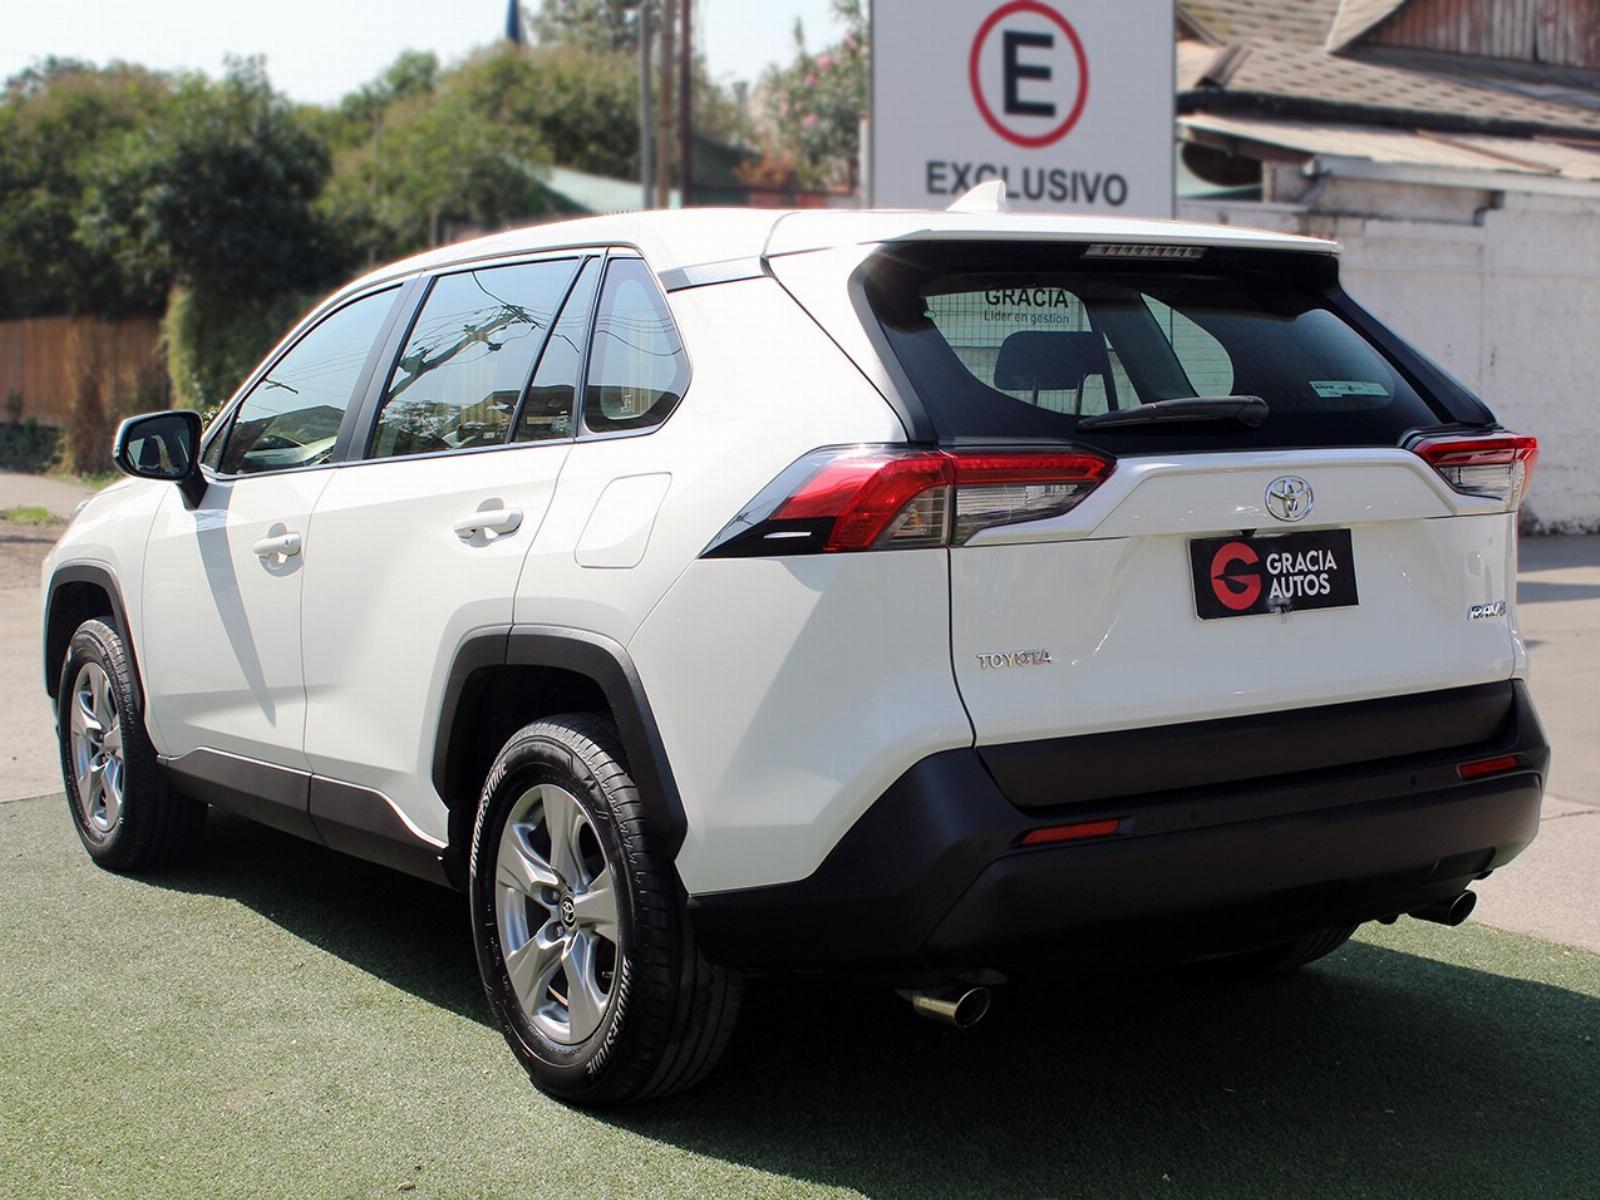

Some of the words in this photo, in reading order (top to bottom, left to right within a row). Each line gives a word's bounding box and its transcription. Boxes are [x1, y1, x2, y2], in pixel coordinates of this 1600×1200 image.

[1003, 30, 1056, 118] E
[926, 160, 1128, 207] EXCLUSIVO
[985, 288, 1069, 308] GRACIA
[1266, 550, 1337, 576] GRACIA
[1269, 573, 1331, 600] AUTOS
[976, 648, 1052, 670] TOYOTA
